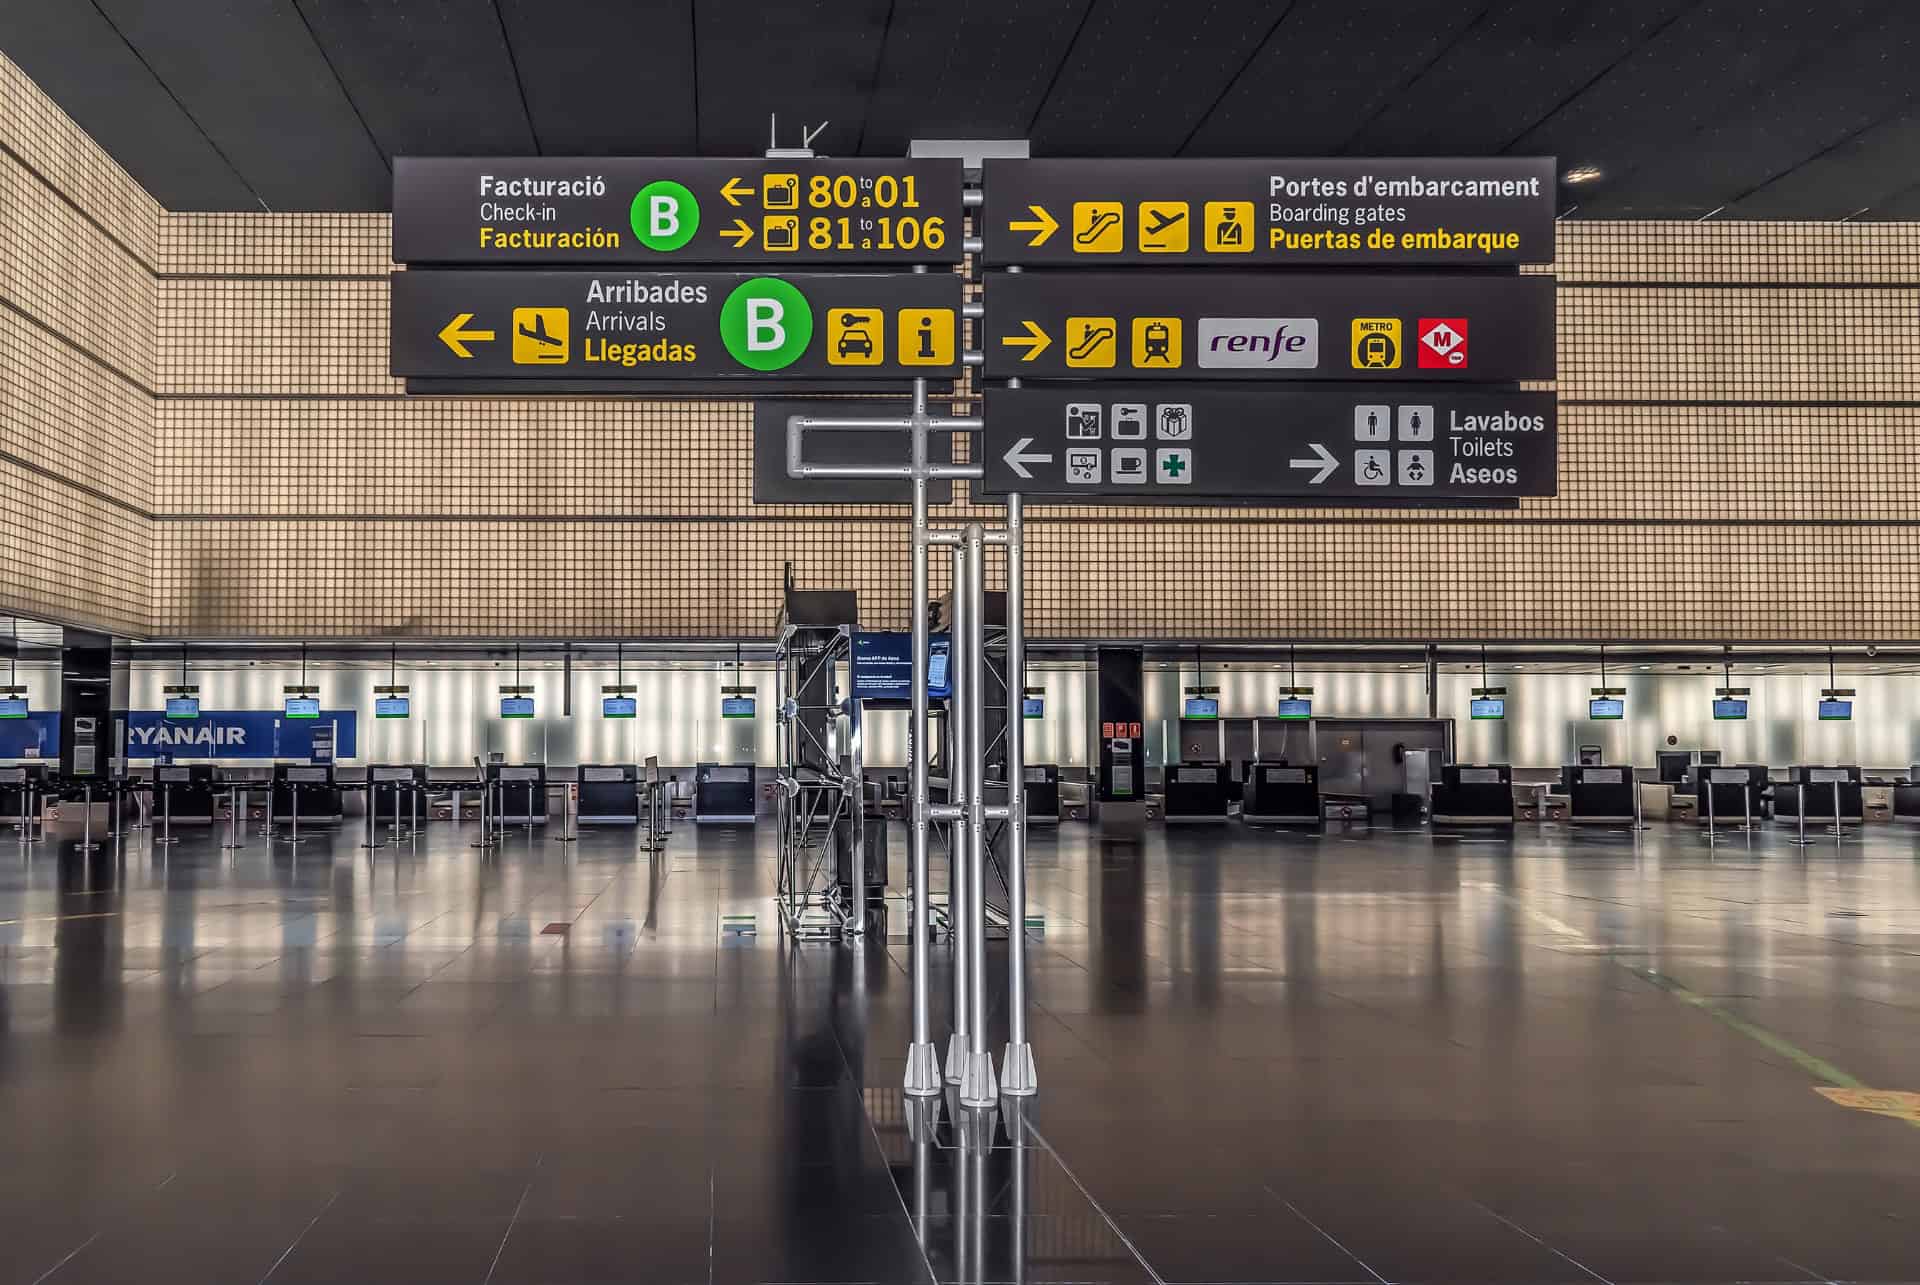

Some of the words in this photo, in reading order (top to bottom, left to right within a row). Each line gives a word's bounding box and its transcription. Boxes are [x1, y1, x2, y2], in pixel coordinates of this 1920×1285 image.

[480, 175, 606, 197] Facturació
[808, 175, 857, 208] 80
[860, 176, 873, 189] to
[874, 175, 920, 208] 01
[1270, 176, 1348, 197] Portes
[1353, 175, 1540, 197] d'embarcament
[480, 203, 556, 222] Check-in
[861, 196, 871, 208] a
[649, 195, 679, 237] B
[860, 217, 873, 231] to
[1269, 203, 1350, 225] Boarding
[1354, 205, 1406, 225] gates
[480, 226, 620, 249] Facturación
[808, 217, 855, 250] 81
[861, 238, 871, 250] a
[877, 216, 945, 250] 106
[1269, 228, 1361, 249] Puertas
[1367, 228, 1396, 249] de
[1400, 228, 1520, 253] embarque
[586, 279, 708, 304] Arribades
[585, 310, 666, 332] Arrivals
[745, 298, 786, 351] B
[1360, 322, 1393, 331] METRO
[1210, 324, 1306, 361] renfe
[1433, 331, 1451, 347] M
[584, 338, 697, 367] Llegadas
[1449, 410, 1545, 432] Lavabos
[1449, 436, 1514, 457] Toilets
[1449, 462, 1518, 484] Aseos
